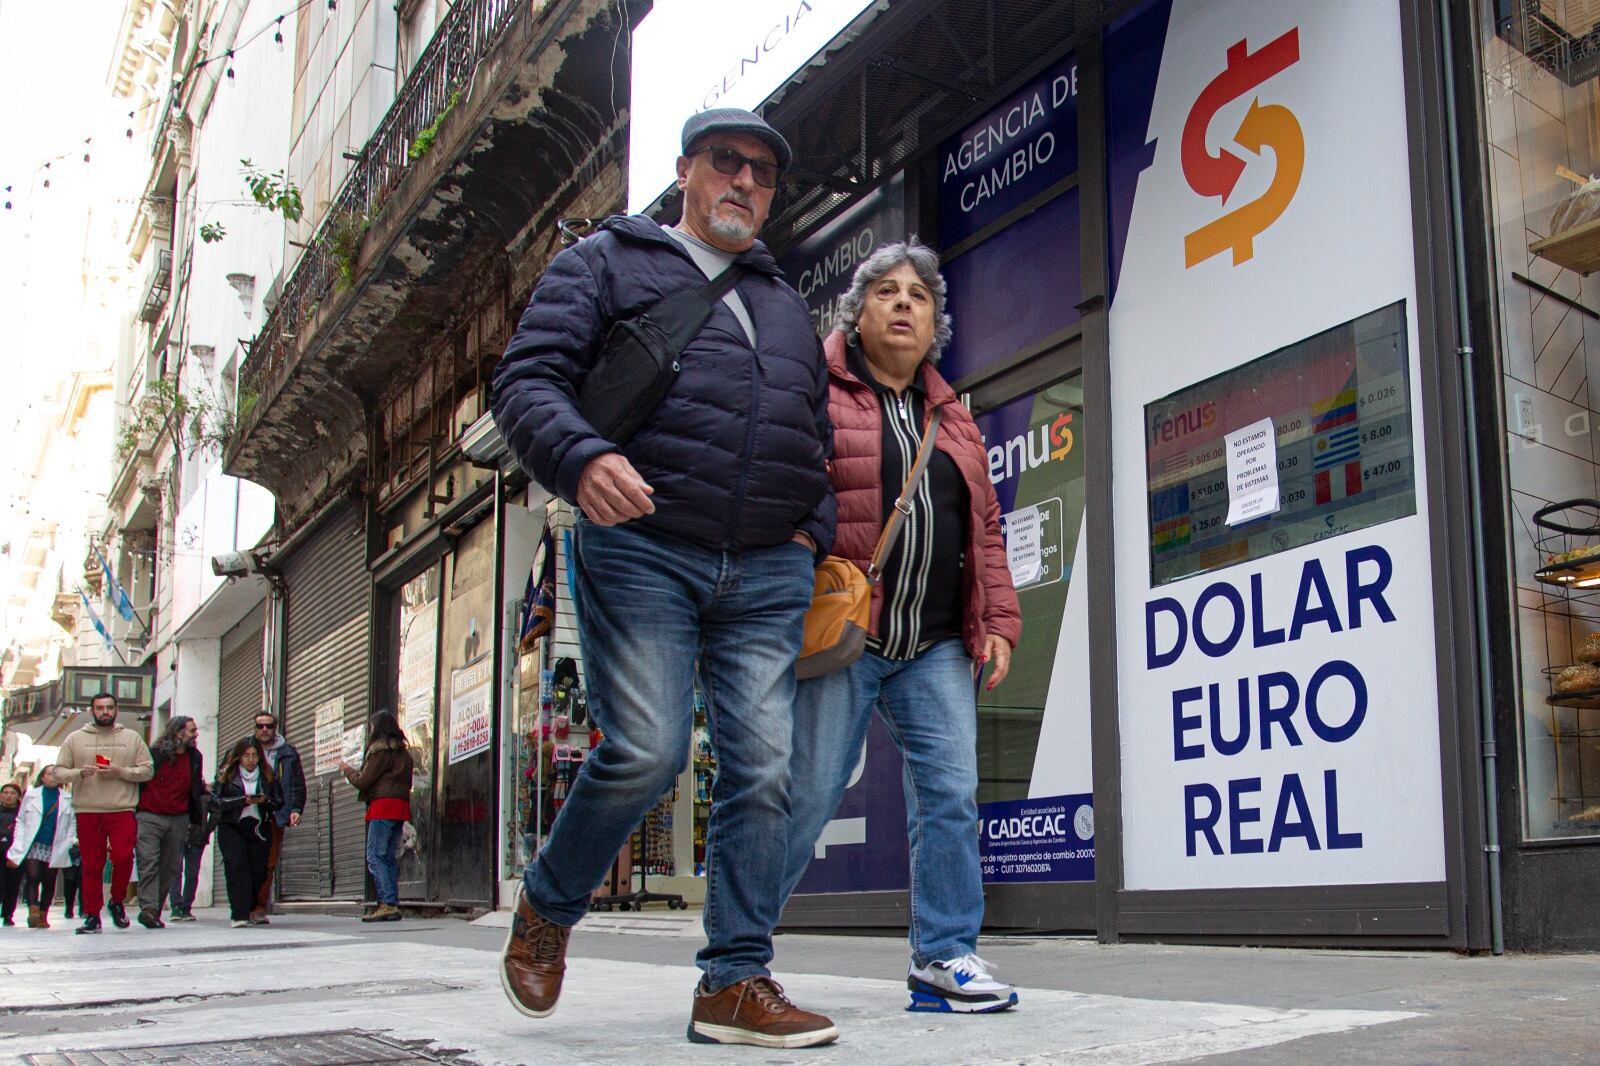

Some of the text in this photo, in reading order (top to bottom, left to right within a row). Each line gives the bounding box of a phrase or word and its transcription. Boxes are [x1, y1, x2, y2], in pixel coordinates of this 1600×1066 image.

[695, 0, 812, 113] GENCIA
[943, 92, 1045, 183] AGENCIA
[960, 131, 1055, 212] CAMBIO
[798, 227, 874, 299] CAMBIO
[1367, 386, 1396, 404] 0.026
[1233, 429, 1267, 448] NO ESTAMOS
[1369, 425, 1392, 441] 8.00
[983, 413, 1073, 485] enus
[1236, 442, 1266, 458] OPERANDO
[1245, 456, 1257, 466] POR
[1372, 460, 1401, 478] 47.00
[1236, 464, 1267, 480] PROBLEMAS
[1236, 474, 1269, 492] DE SISTEMAS
[1145, 544, 1397, 671] DOLAR
[1172, 660, 1369, 762] EURO
[1184, 769, 1363, 857] REAL
[988, 814, 1066, 840] CADECAC
[988, 854, 996, 862] de
[997, 853, 1018, 863] registro
[1018, 852, 1042, 864] agencia
[1043, 851, 1052, 860] de
[1052, 850, 1075, 860] cambio
[983, 866, 995, 874] SAS
[1001, 865, 1014, 874] CUIT
